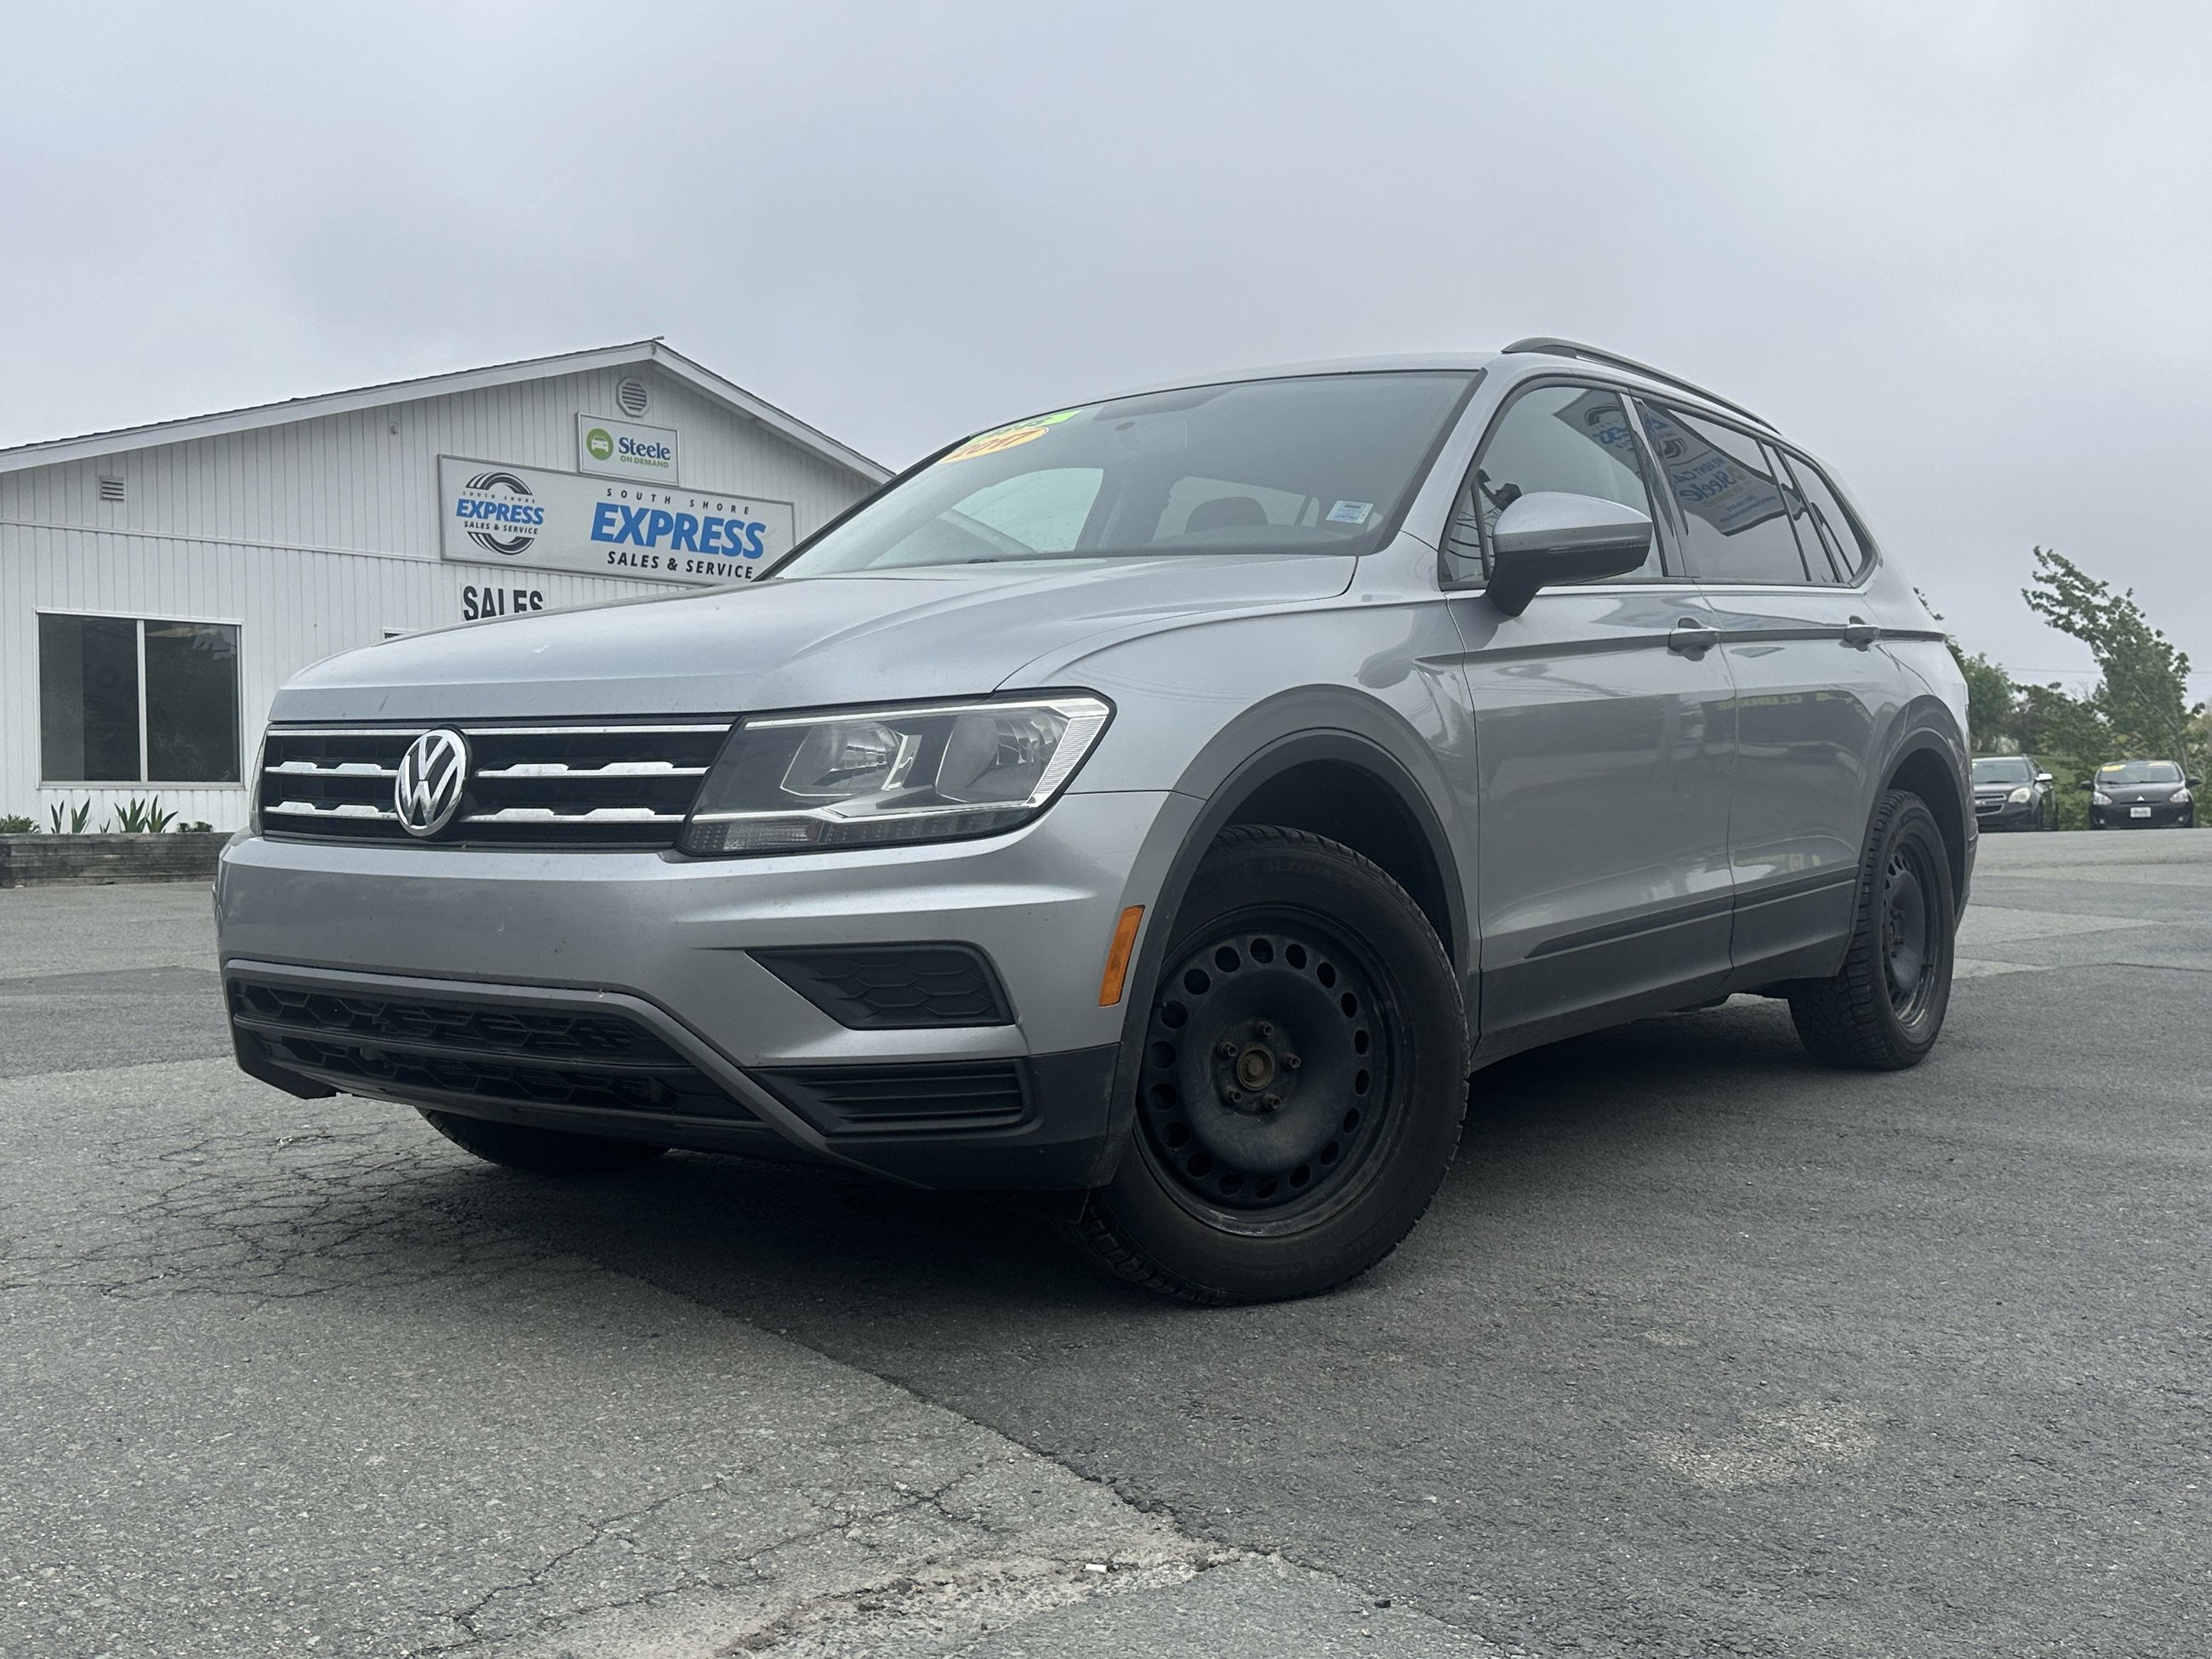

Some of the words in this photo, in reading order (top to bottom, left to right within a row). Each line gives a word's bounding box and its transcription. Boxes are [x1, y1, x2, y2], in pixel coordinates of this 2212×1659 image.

[619, 436, 670, 460] Steele
[620, 455, 632, 464] ON
[634, 457, 669, 469] DEMAND
[456, 499, 544, 526] EXPRESS
[607, 488, 671, 505] SOUTH
[690, 499, 750, 515] SHORE
[464, 521, 490, 530] SALES
[503, 525, 539, 535] SERVICE
[590, 502, 767, 560] EXPRESS
[607, 551, 659, 569] SALES
[667, 558, 678, 571] &
[686, 560, 753, 579] SERVICE
